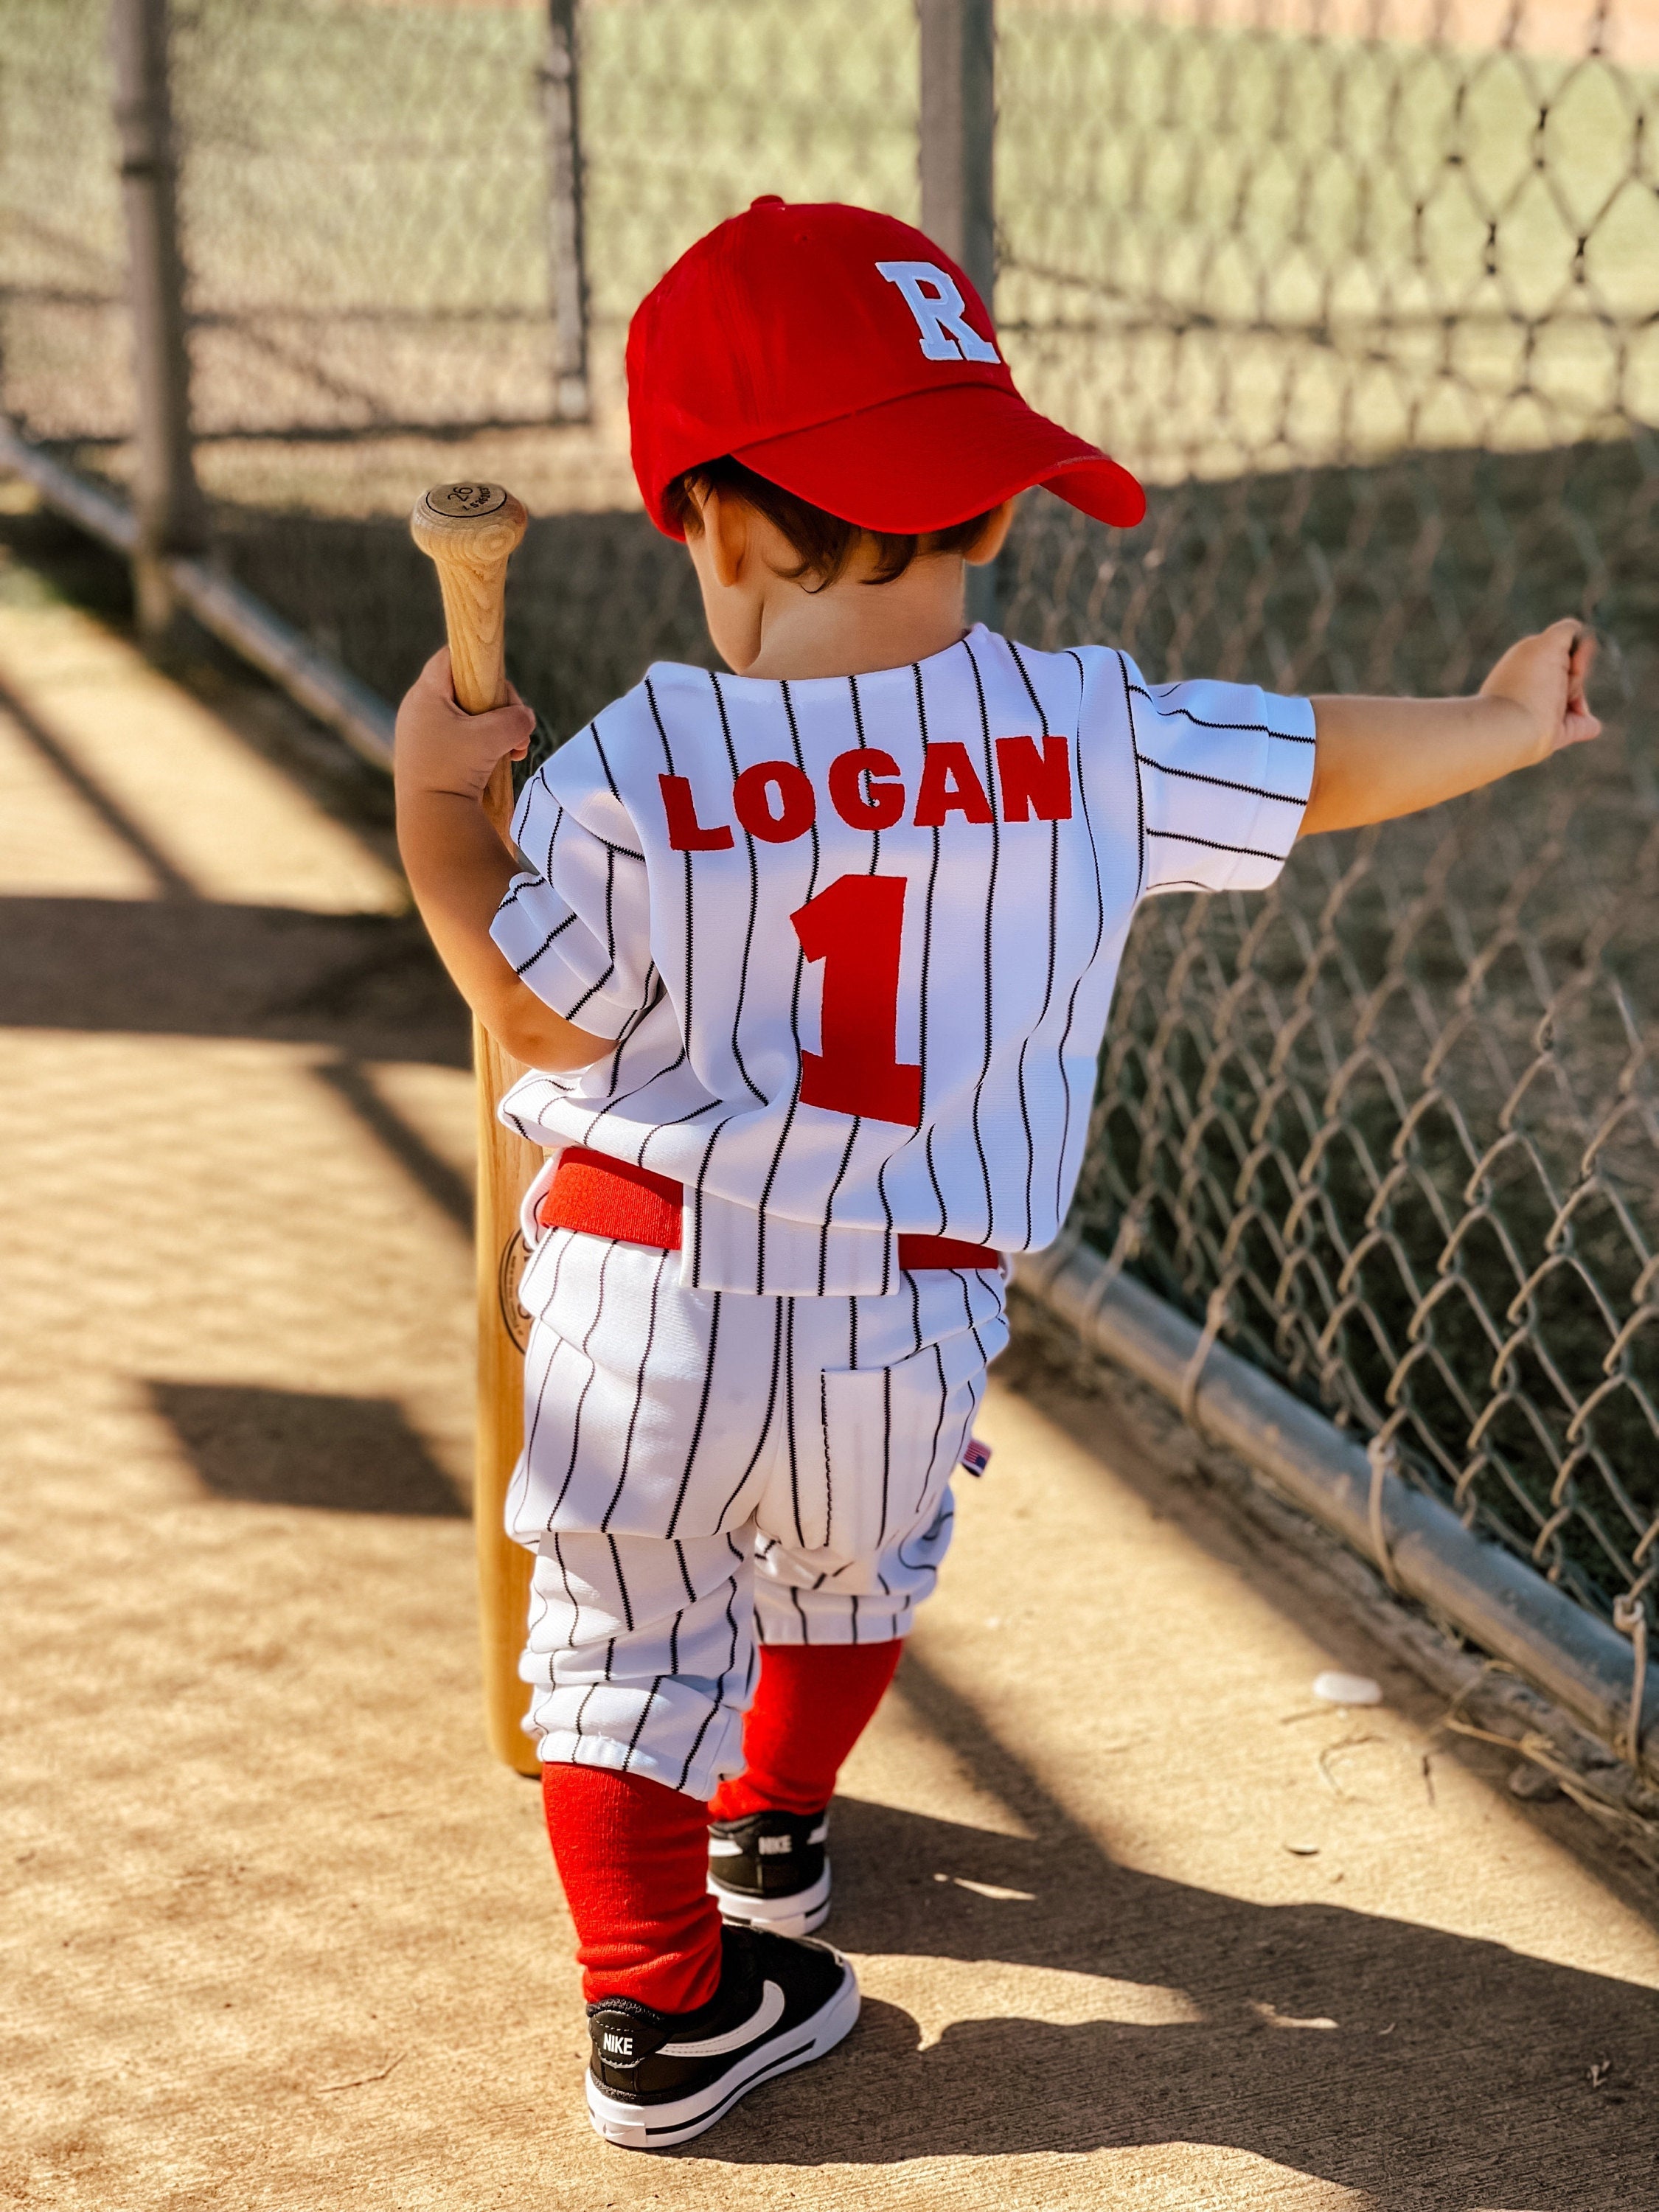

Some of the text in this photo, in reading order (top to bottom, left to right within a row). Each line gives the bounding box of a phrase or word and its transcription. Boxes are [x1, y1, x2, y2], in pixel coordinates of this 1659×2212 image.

[875, 261, 1001, 364] R
[447, 487, 473, 502] 26
[658, 735, 1072, 852] LOGAN
[789, 874, 922, 1128] 1
[758, 1834, 792, 1855] NIKE
[603, 2032, 633, 2056] NIKE
